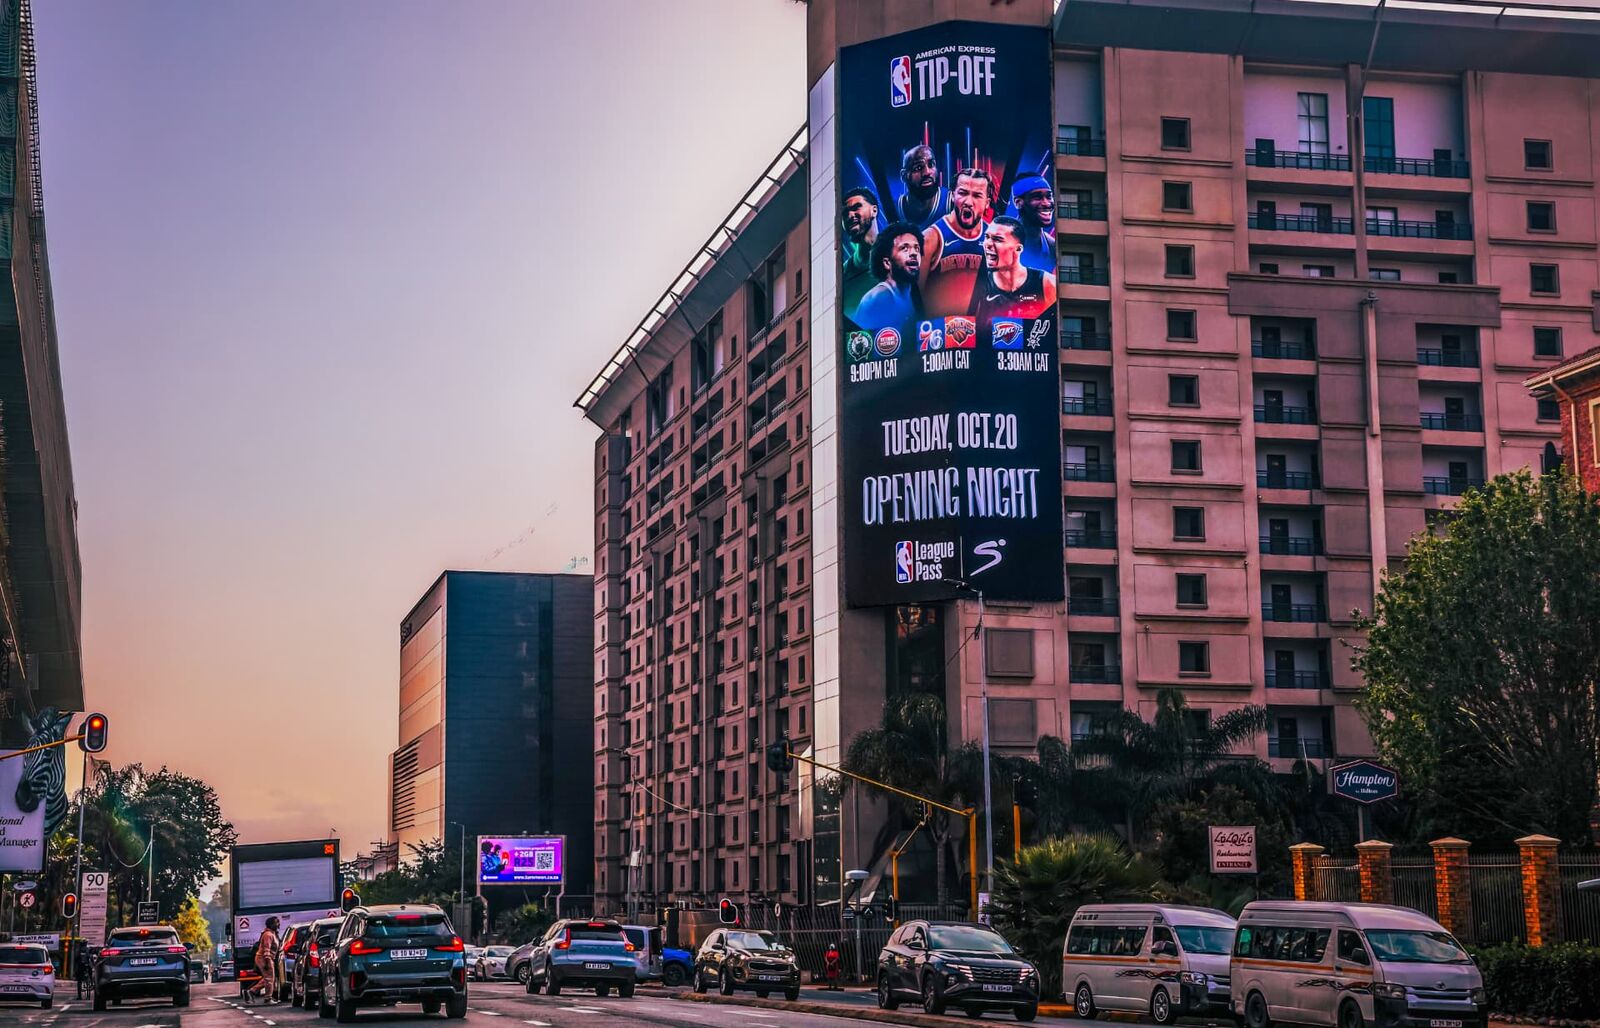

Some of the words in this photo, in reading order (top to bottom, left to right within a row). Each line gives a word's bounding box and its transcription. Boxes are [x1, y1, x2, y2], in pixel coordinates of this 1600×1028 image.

[915, 45, 956, 60] AMERICAN
[958, 45, 996, 54] EXPRESS
[915, 55, 996, 101] TIP-OFF
[850, 361, 882, 383] 9:00PM
[884, 358, 898, 378] CAT
[922, 350, 953, 373] 1:00AM
[955, 350, 971, 369] CAT
[998, 351, 1032, 371] 3:30AM
[1034, 352, 1050, 372] CAT
[882, 413, 953, 457] TUESDAY,
[957, 412, 1018, 449] OCT.20
[862, 467, 960, 525] OPENING
[966, 467, 1040, 519] NIGHT
[915, 540, 955, 562] League
[915, 562, 943, 581] Pass
[1336, 771, 1395, 787] Hampton
[1216, 849, 1252, 857] Restaurant
[87, 874, 104, 887] 90
